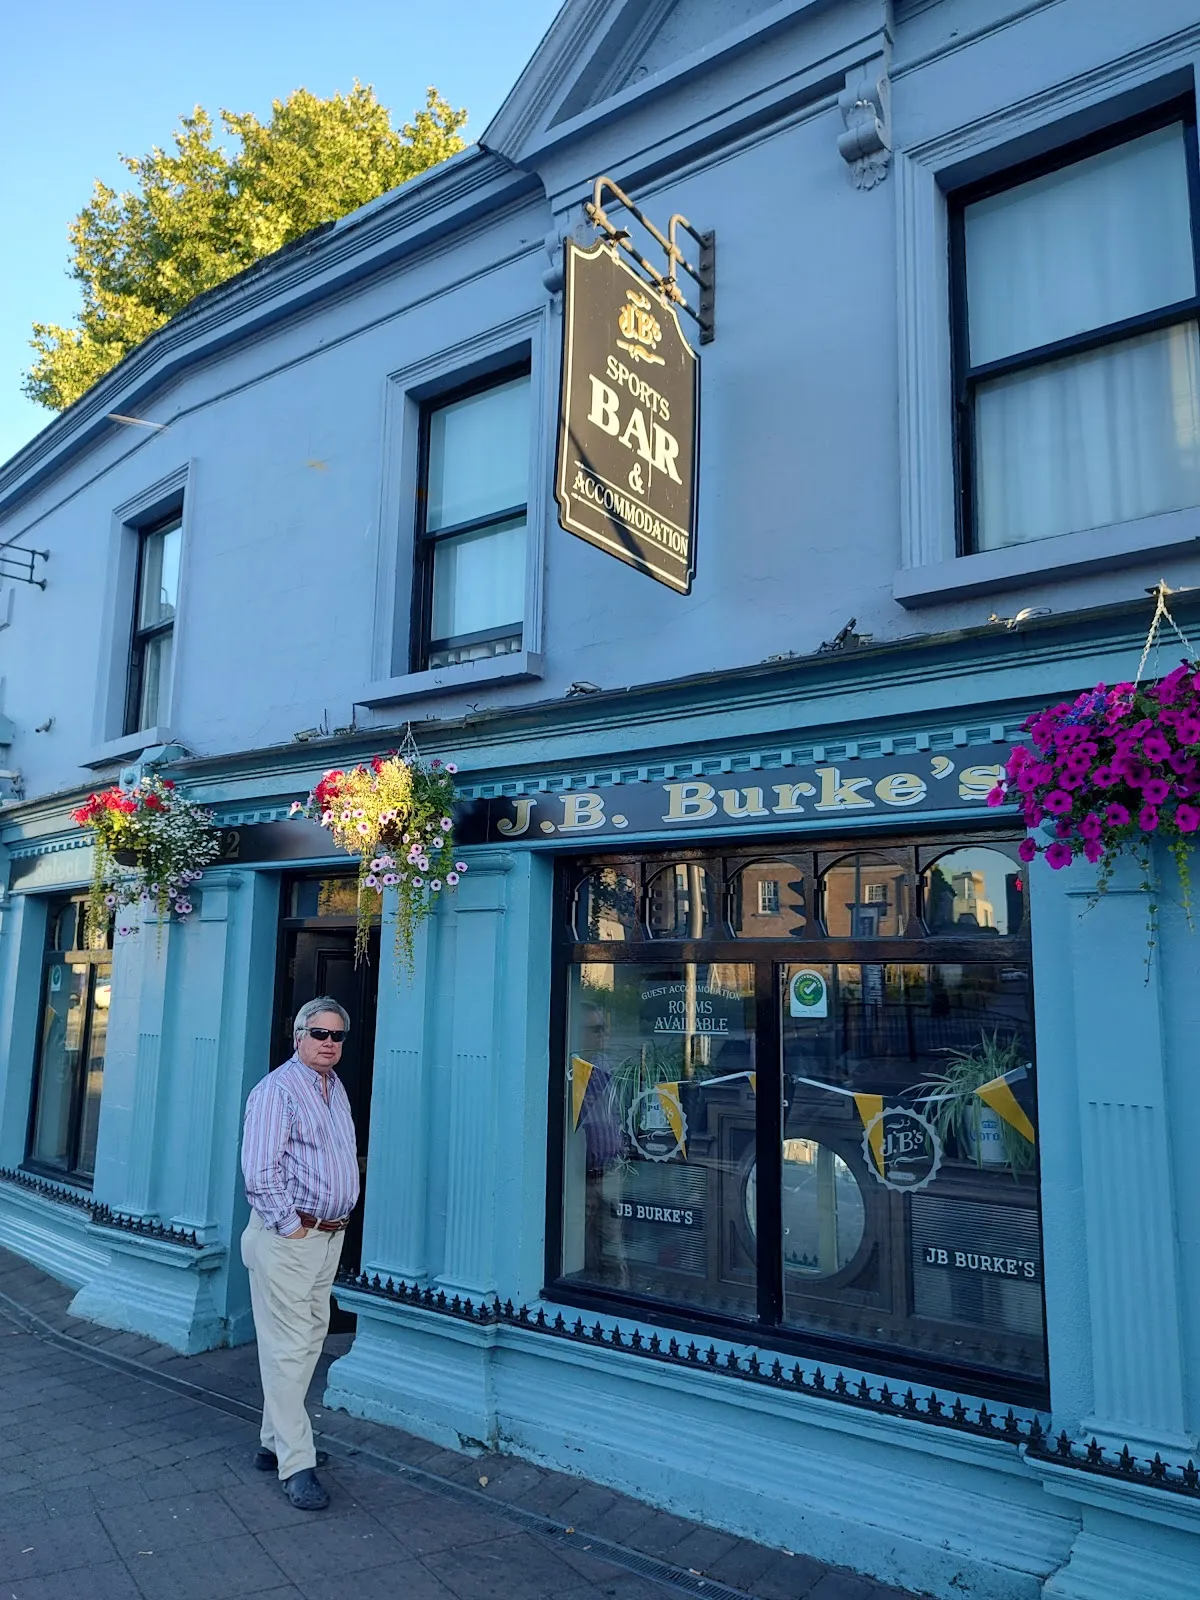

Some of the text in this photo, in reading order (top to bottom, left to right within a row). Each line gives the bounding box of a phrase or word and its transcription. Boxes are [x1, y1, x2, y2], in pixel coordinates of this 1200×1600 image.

[605, 355, 671, 421] SPORTS
[587, 373, 683, 485] BAR
[628, 462, 645, 494] &
[572, 470, 689, 557] ACCOMMODATION
[497, 756, 1008, 836] J.B. Burke's
[641, 984, 741, 1001] GUEST ACCOMODATION
[668, 1000, 713, 1014] ROOMS
[616, 1202, 693, 1225] JB BURKE'S
[926, 1247, 1036, 1278] JB BURKE'S
